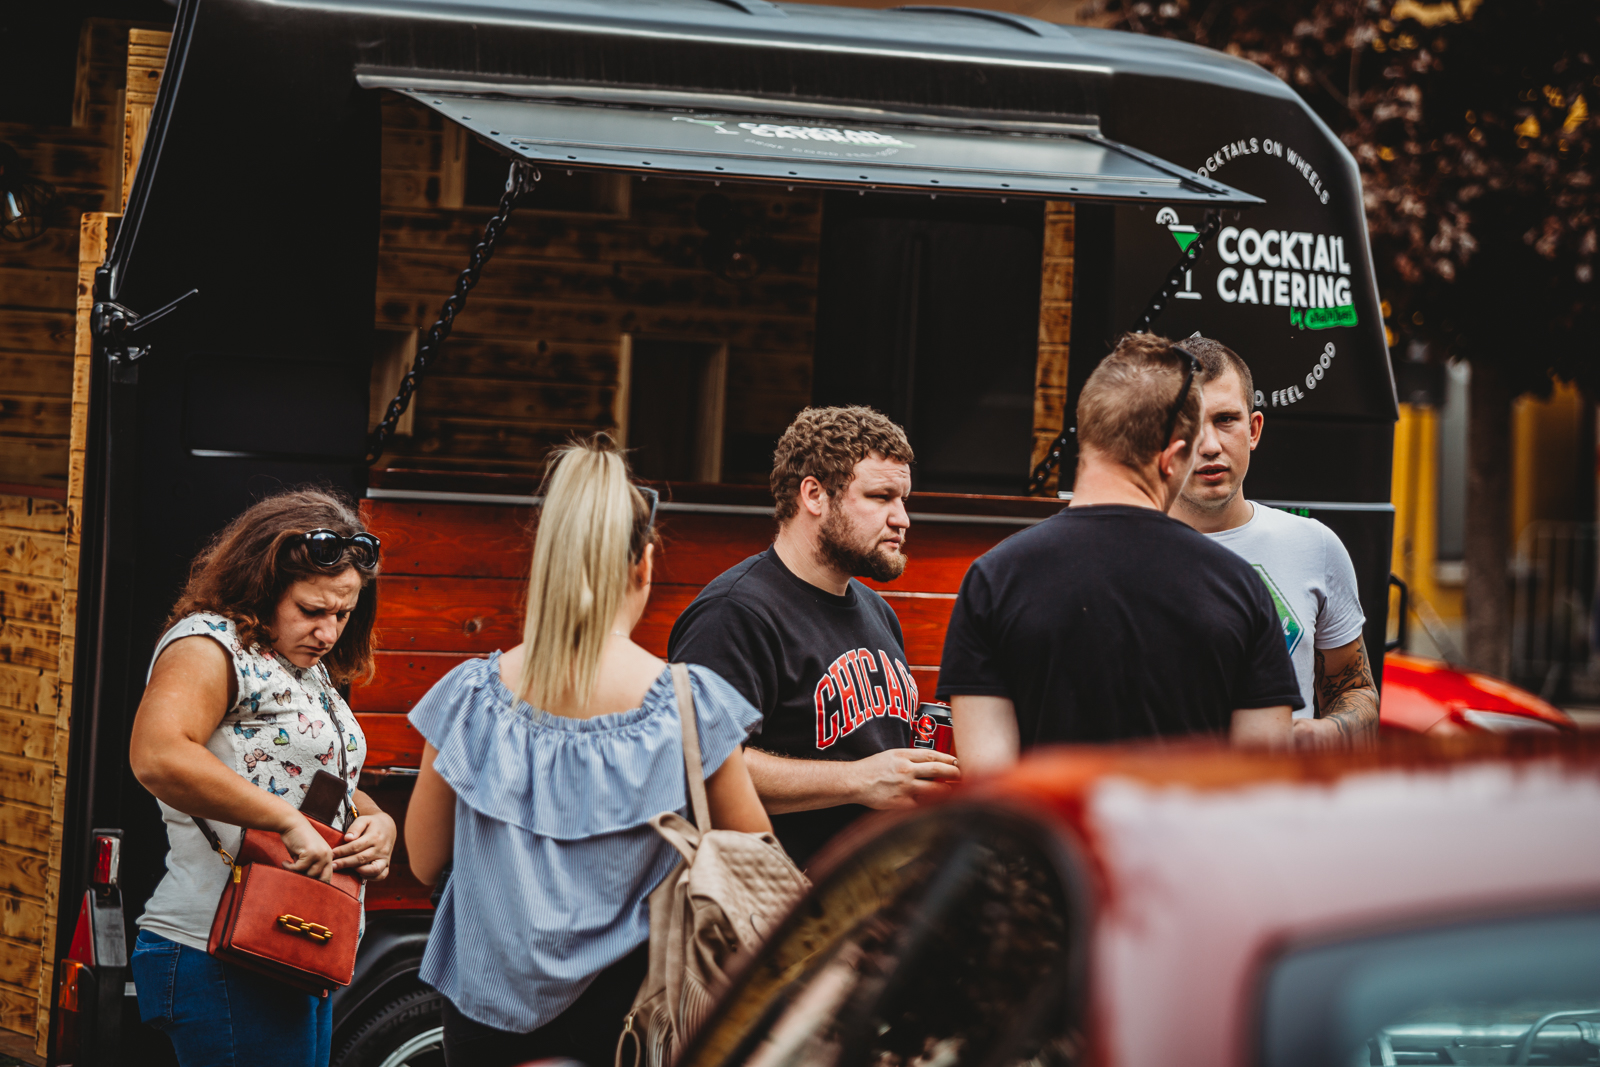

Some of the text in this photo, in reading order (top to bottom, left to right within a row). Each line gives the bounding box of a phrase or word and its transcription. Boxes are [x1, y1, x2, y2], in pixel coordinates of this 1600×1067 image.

[1197, 137, 1330, 205] OCKTAILS ON WHEELS
[1217, 226, 1351, 275] COCKTAIL
[1216, 267, 1352, 309] CATERING
[1272, 384, 1304, 407] FEEL
[1305, 341, 1336, 390] GOOD
